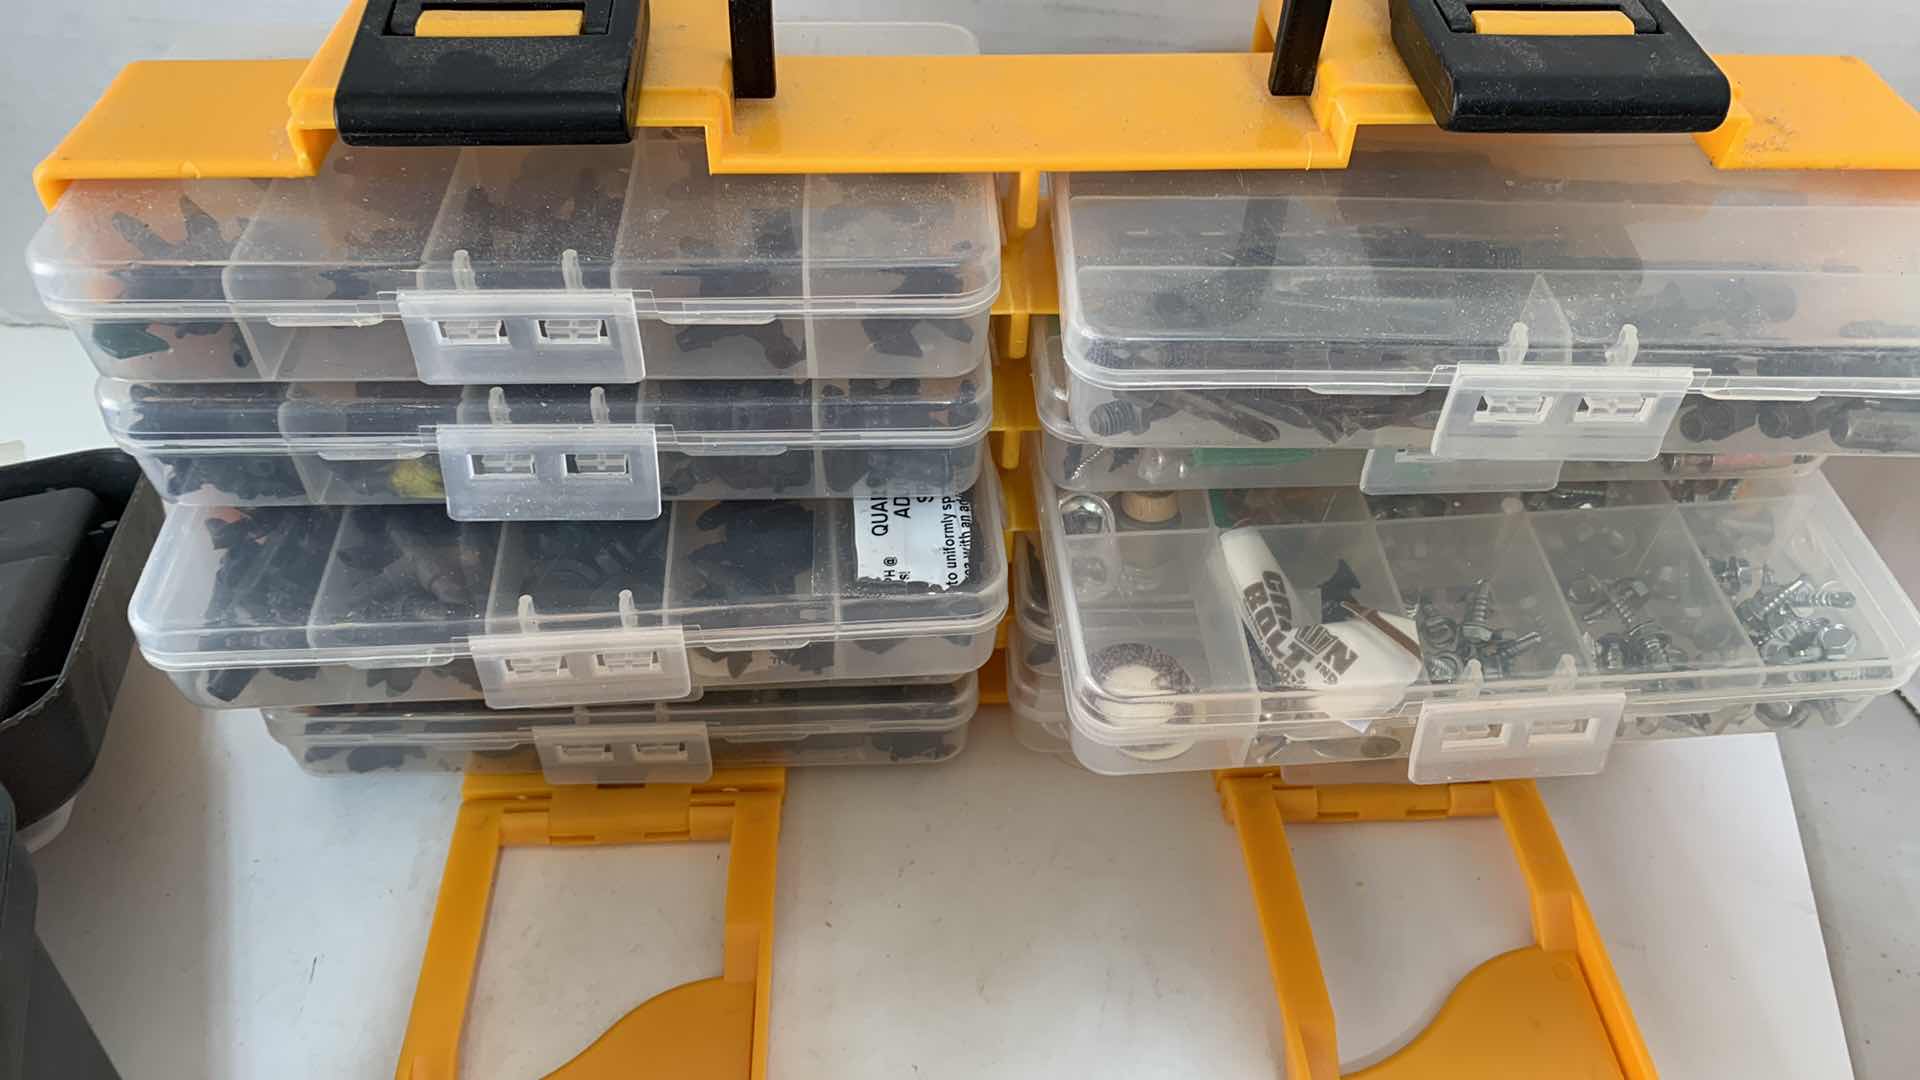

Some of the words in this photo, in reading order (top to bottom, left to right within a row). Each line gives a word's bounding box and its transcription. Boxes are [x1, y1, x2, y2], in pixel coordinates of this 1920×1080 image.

[941, 513, 957, 568] uniformly
[945, 572, 958, 585] to
[1243, 581, 1315, 669] BOLT
